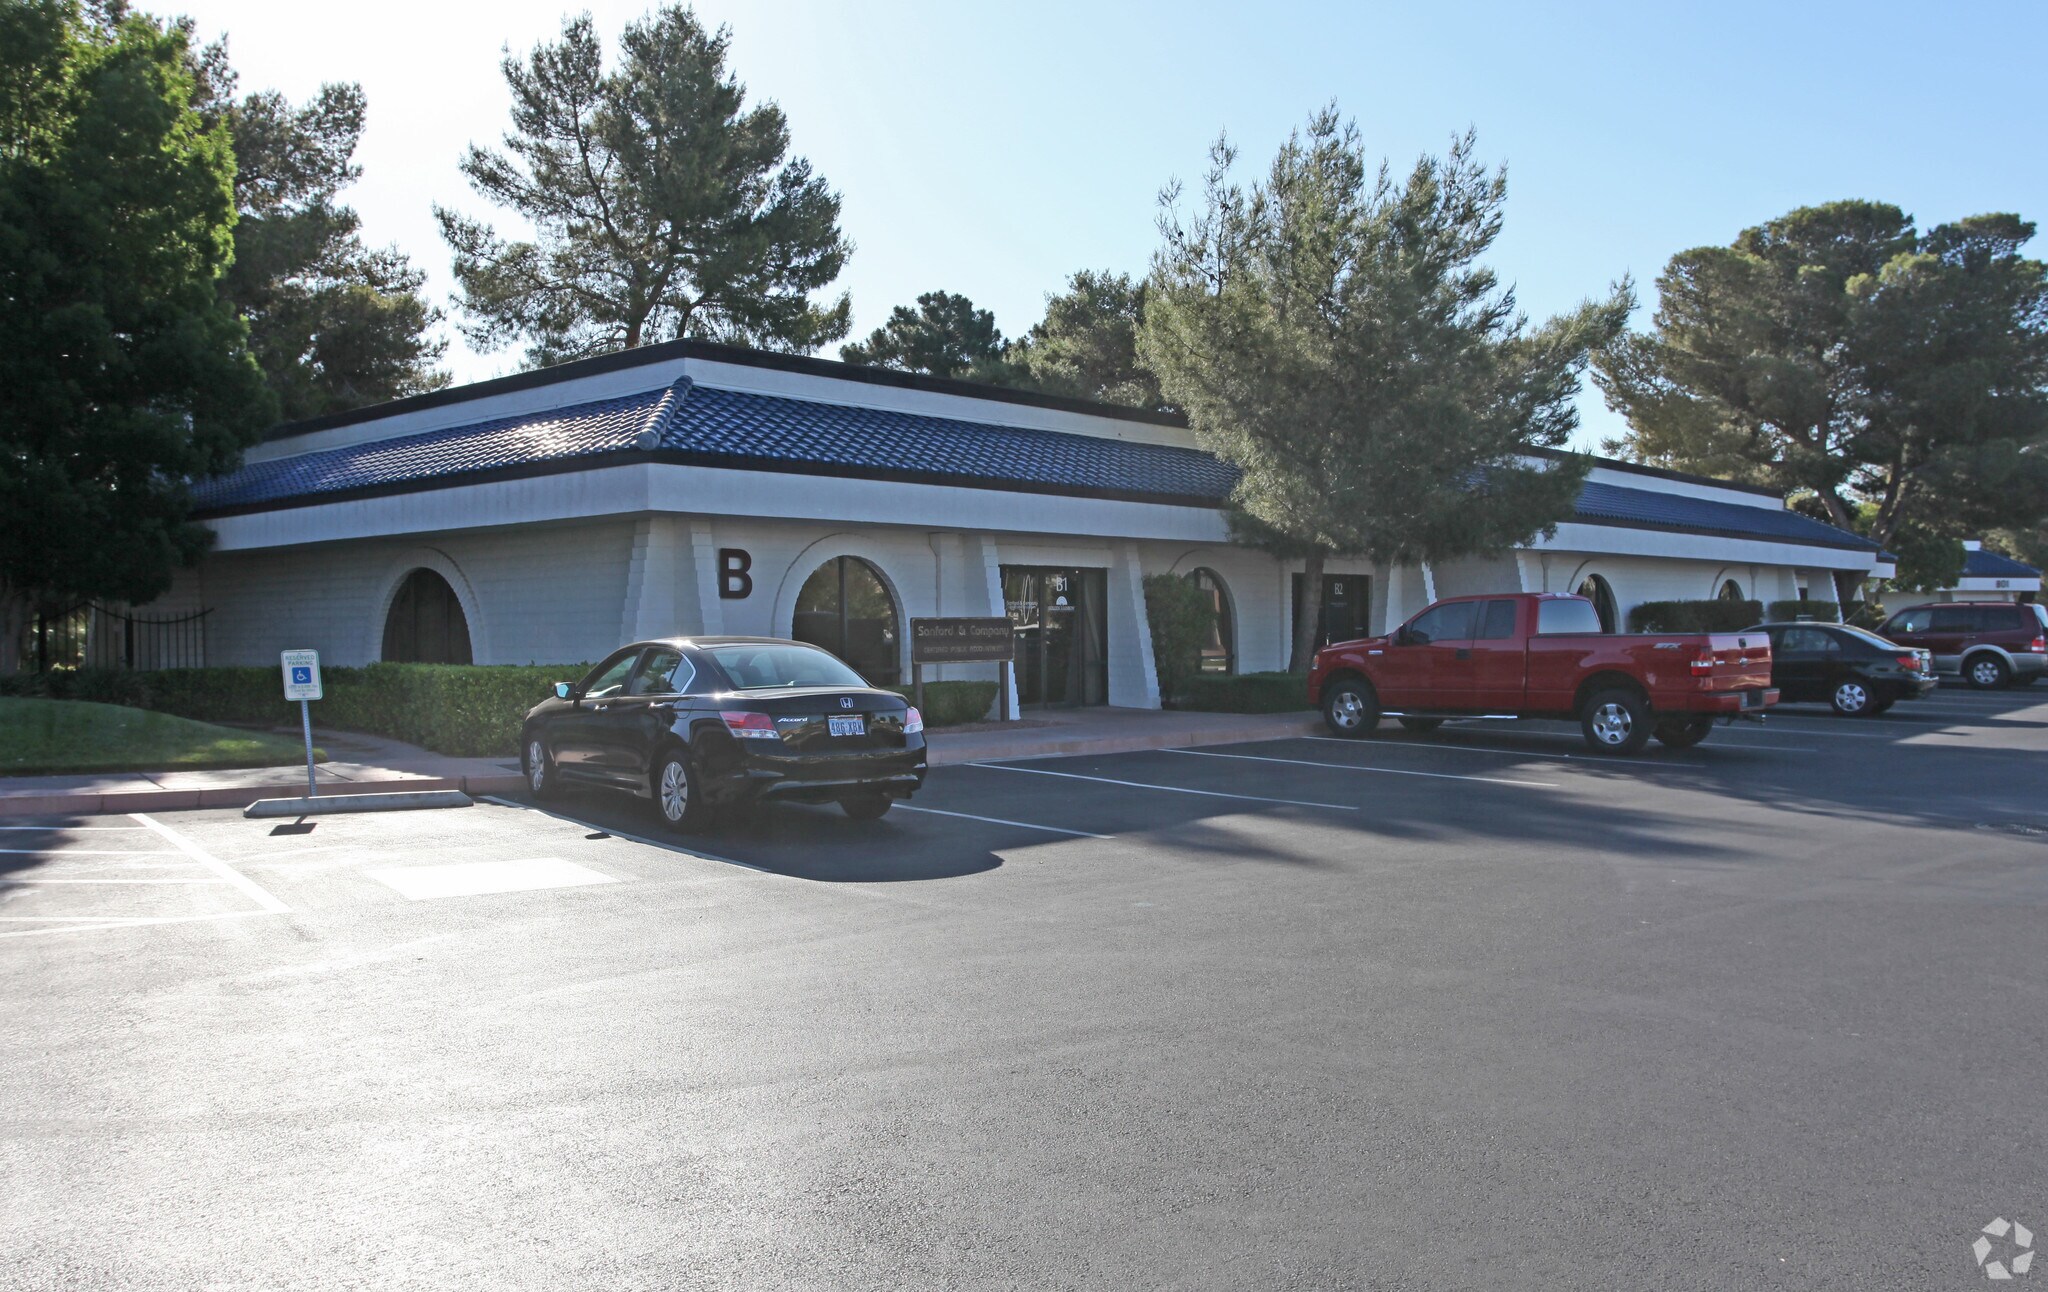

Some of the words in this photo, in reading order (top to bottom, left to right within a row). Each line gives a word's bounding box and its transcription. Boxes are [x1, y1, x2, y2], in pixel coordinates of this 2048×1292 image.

[718, 547, 753, 600] B
[1056, 576, 1068, 592] B1
[1334, 582, 1343, 595] B2
[918, 625, 954, 637] Sanford
[958, 625, 966, 636] &
[970, 625, 1010, 638] Company
